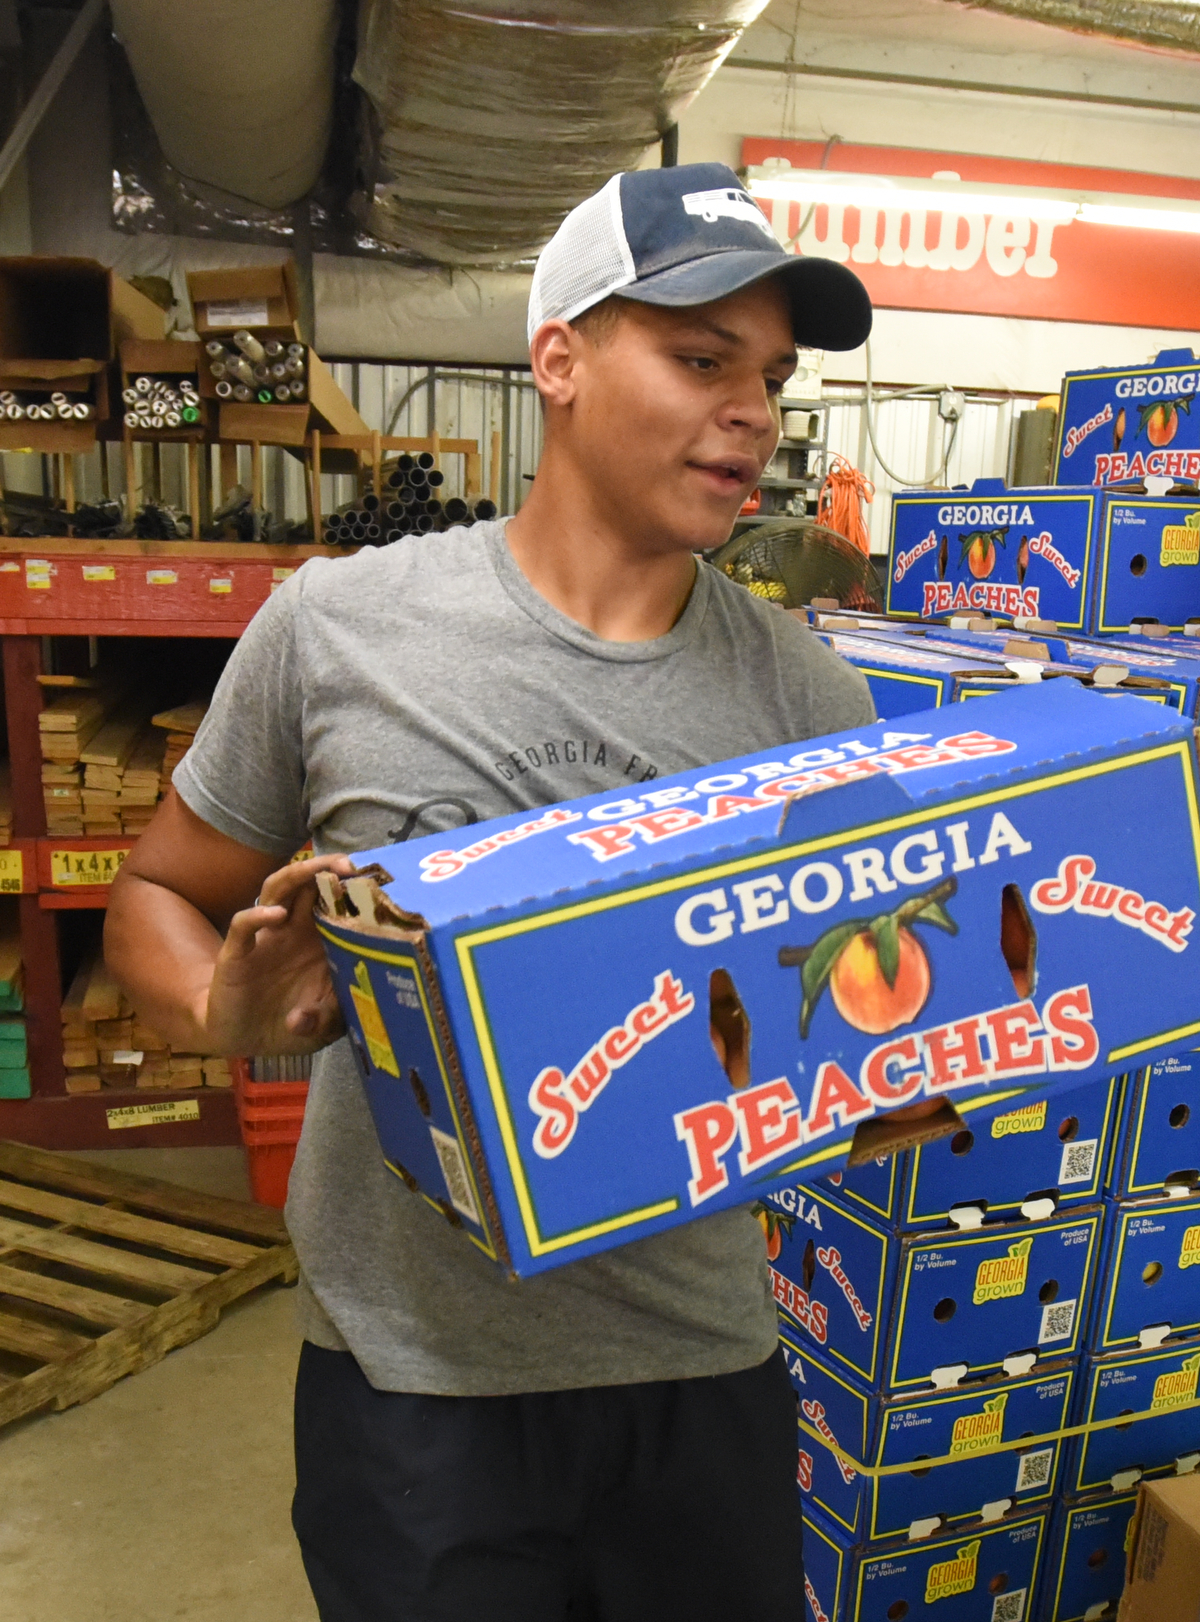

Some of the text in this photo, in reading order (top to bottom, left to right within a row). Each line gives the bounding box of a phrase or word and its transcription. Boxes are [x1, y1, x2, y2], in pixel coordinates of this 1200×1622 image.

[1063, 403, 1114, 457] Sweet
[937, 505, 1034, 526] GEORGIA
[894, 529, 937, 583] Sweet
[1029, 531, 1081, 589] Sweet
[1161, 550, 1199, 565] grown
[921, 581, 1040, 618] PEACHES
[495, 739, 608, 781] GEORGIA
[586, 730, 933, 821] GEORGIA
[420, 808, 583, 883] Sweet
[89, 853, 98, 871] 4
[675, 812, 1031, 947] GEORGIA
[1030, 855, 1197, 953] Sweet
[526, 970, 695, 1160] Sweet
[672, 983, 1102, 1206] PEACHES
[137, 1103, 175, 1114] LUMBER
[178, 1112, 199, 1120] 4010
[995, 1115, 1043, 1133] grown
[1060, 1228, 1089, 1239] Produce
[1139, 1224, 1165, 1234] Volume
[1064, 1236, 1087, 1245] of USA
[914, 1258, 957, 1271] by Volume
[978, 1258, 1024, 1285] GEORGIA
[816, 1246, 873, 1332] Sweet
[976, 1280, 1023, 1300] grown
[1036, 1381, 1065, 1393] Produce
[1040, 1389, 1064, 1399] of USA
[1155, 1372, 1196, 1398] GEORGIA
[890, 1417, 932, 1431] by Volume
[954, 1413, 1000, 1441] GEORGIA
[1009, 1526, 1037, 1537] Produce
[1013, 1534, 1036, 1543] of USA
[867, 1566, 907, 1580] by Volume
[930, 1557, 975, 1587] GEORGIA
[928, 1579, 973, 1599] grown
